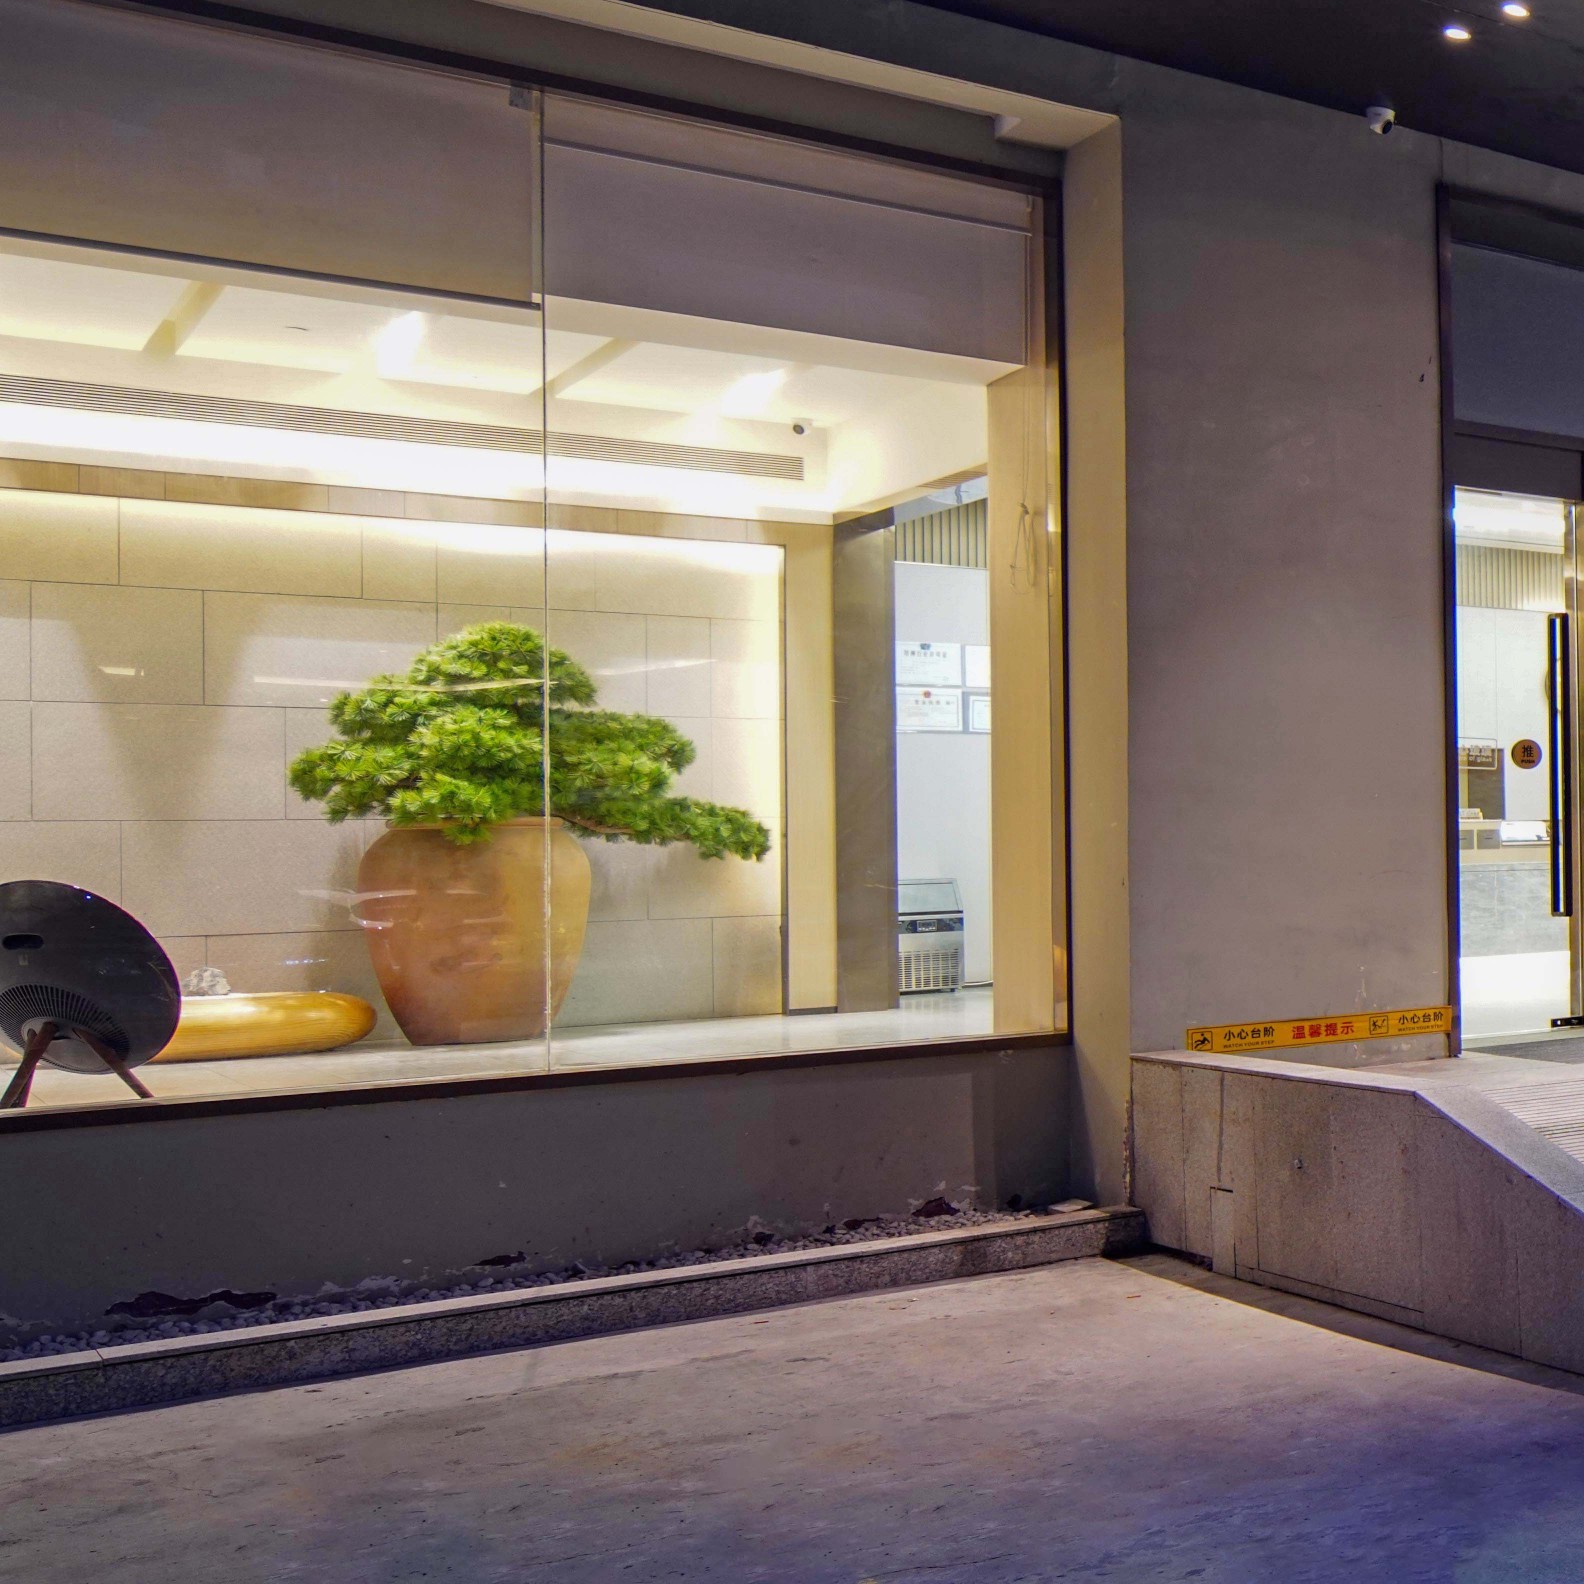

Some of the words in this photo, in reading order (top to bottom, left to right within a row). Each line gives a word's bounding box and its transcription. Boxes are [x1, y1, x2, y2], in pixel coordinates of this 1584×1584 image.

[1521, 745, 1534, 758] 推
[1398, 1011, 1444, 1025] 小心台阶
[1223, 1026, 1276, 1041] 小心台阶
[1292, 1021, 1355, 1040] 温馨提示
